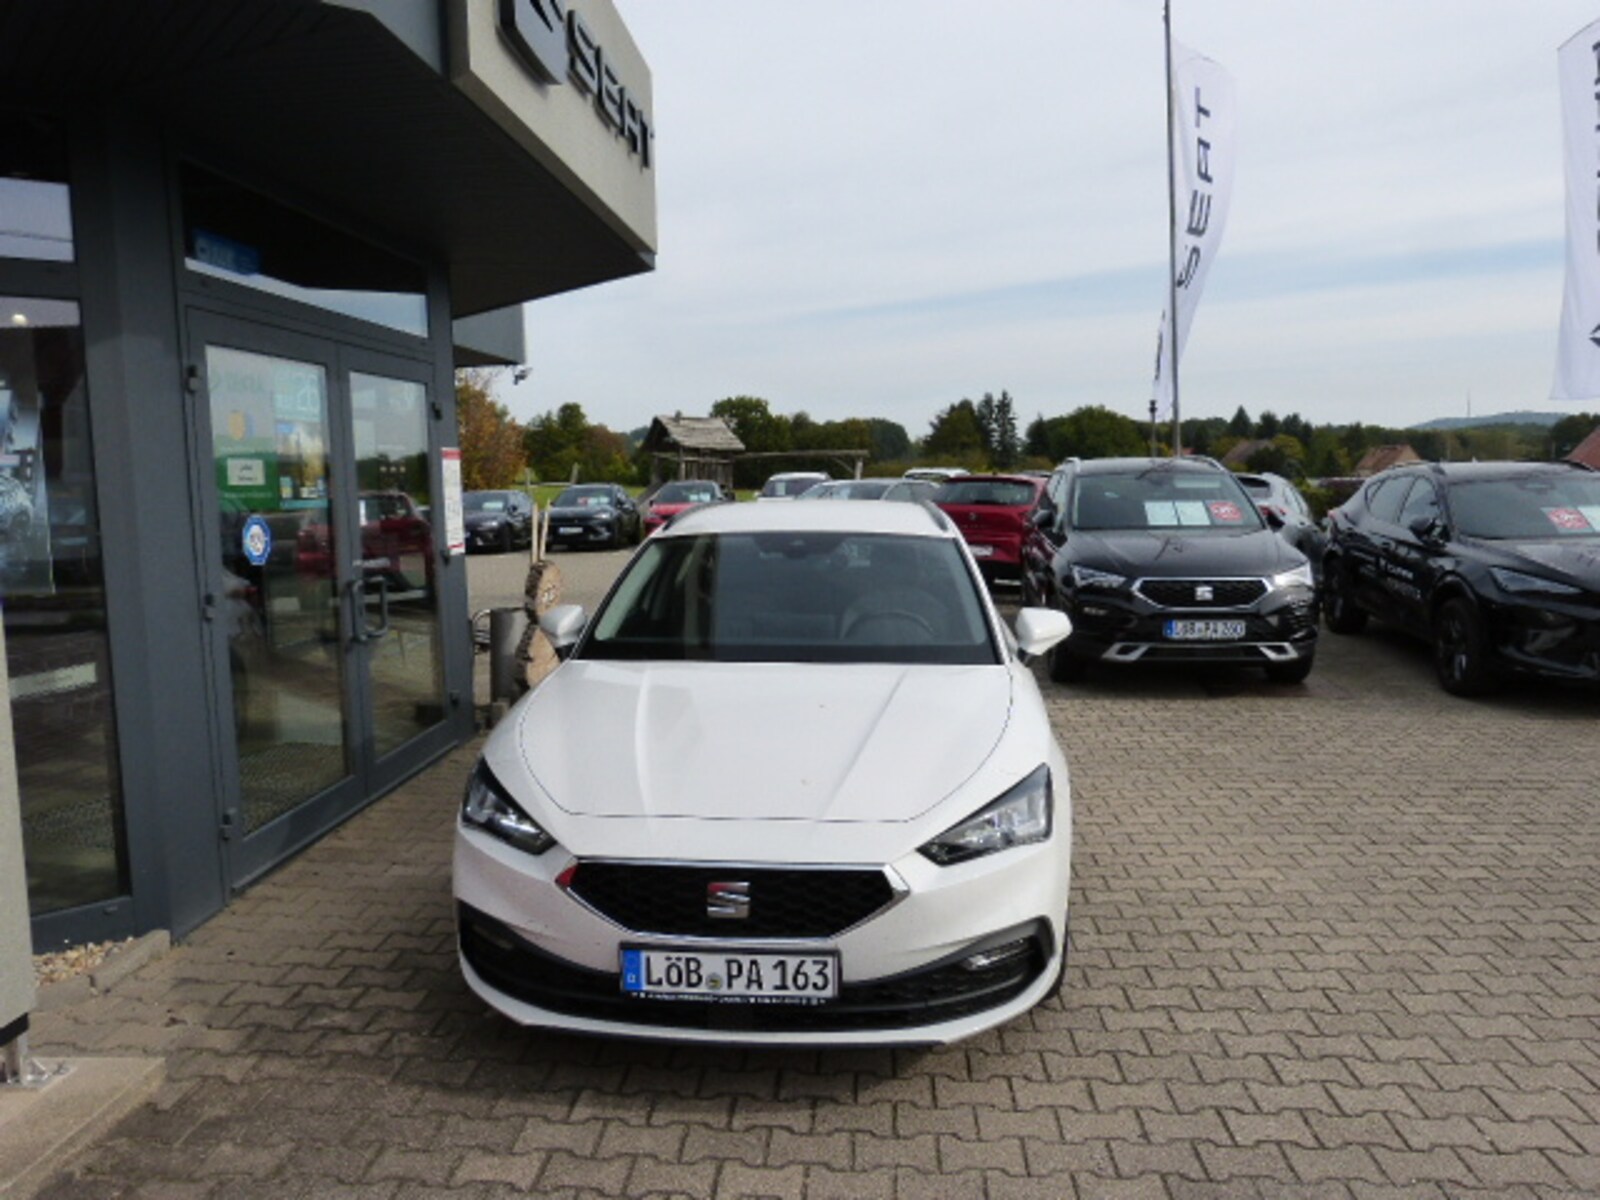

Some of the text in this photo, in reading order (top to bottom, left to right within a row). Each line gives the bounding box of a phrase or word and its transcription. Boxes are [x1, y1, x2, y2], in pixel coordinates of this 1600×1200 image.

[567, 9, 651, 169] SEAT
[1176, 87, 1213, 289] SEAT
[646, 955, 829, 991] LÖB PA 163
